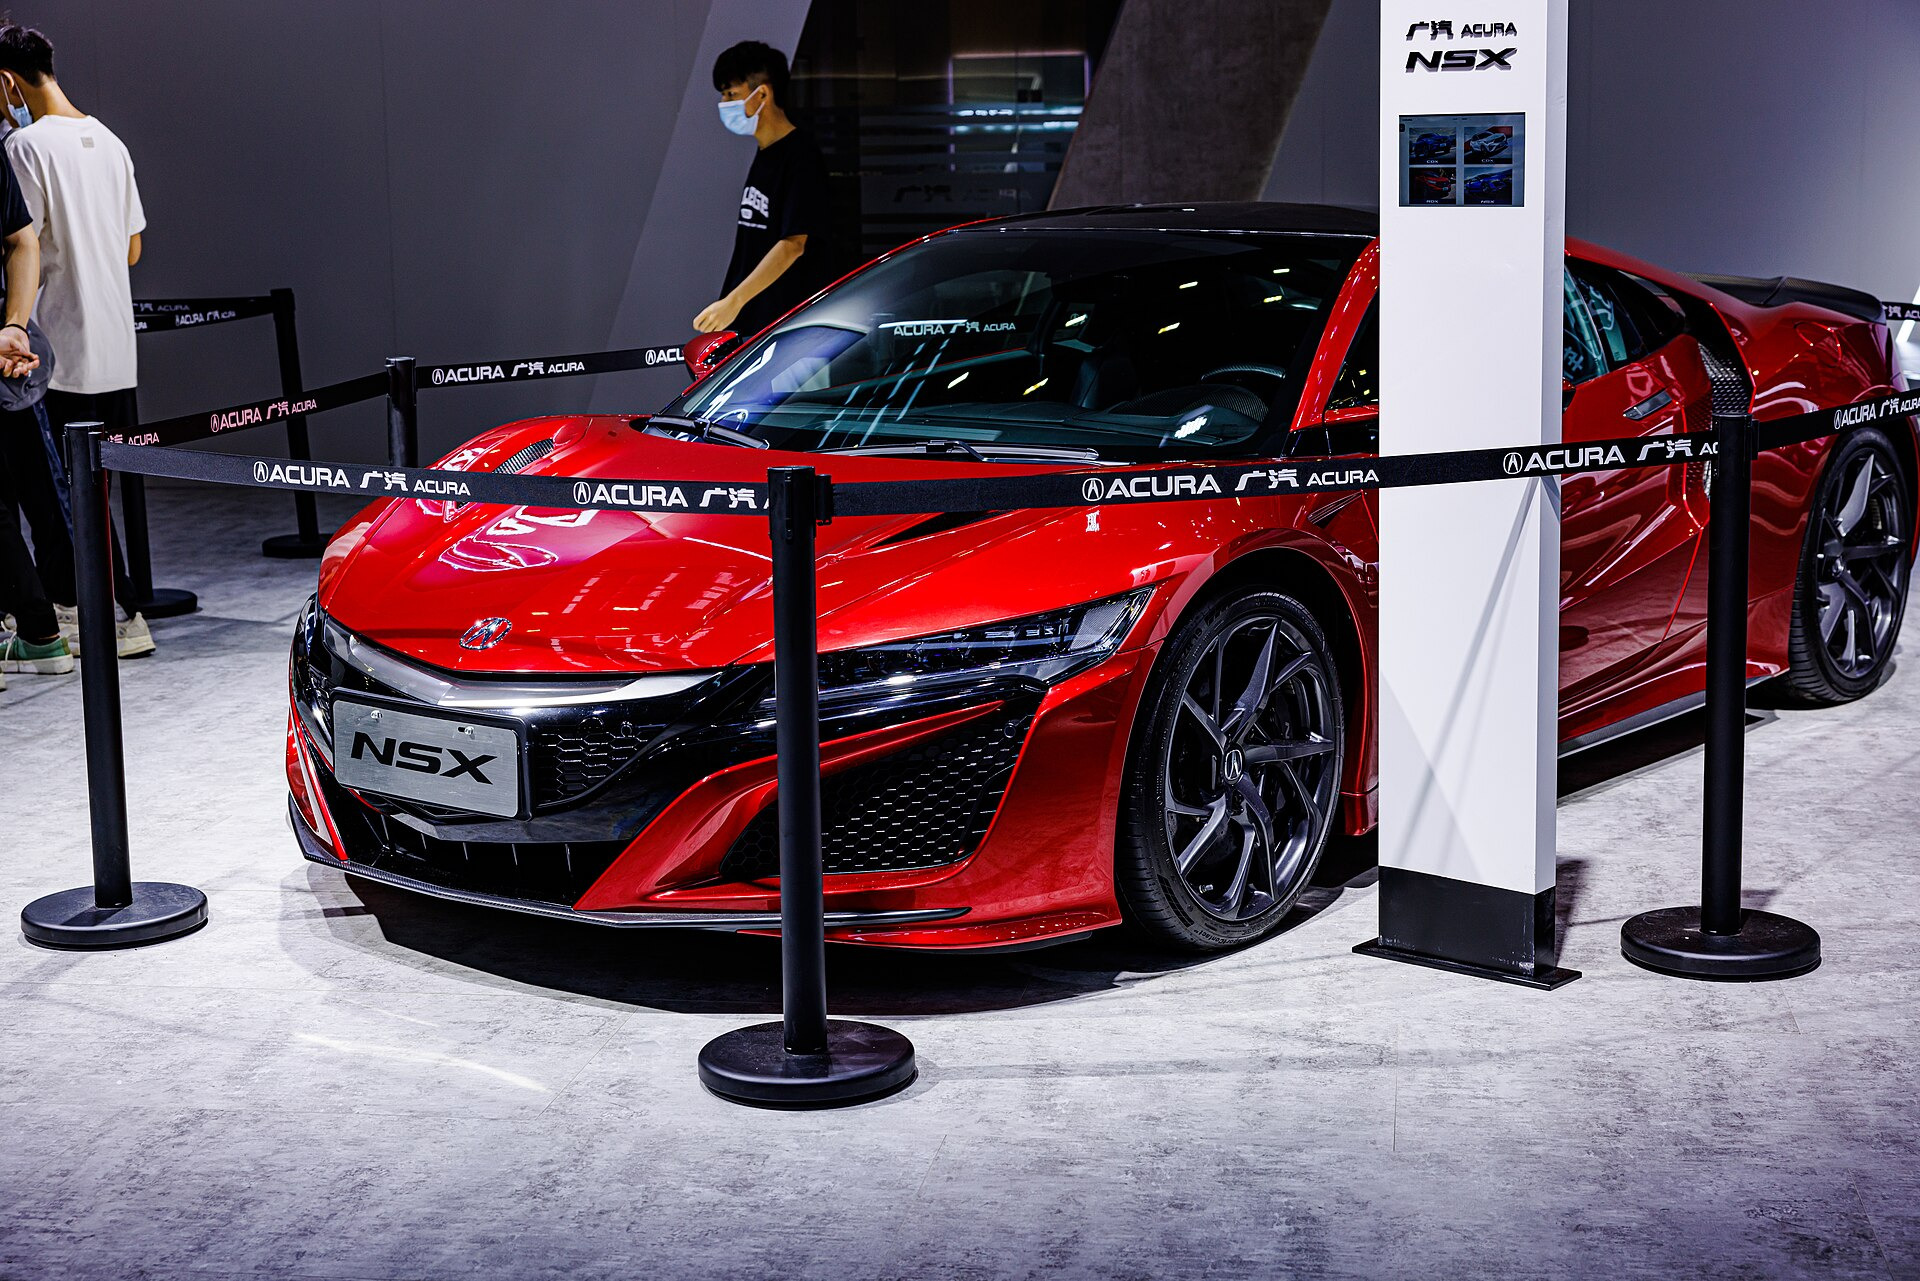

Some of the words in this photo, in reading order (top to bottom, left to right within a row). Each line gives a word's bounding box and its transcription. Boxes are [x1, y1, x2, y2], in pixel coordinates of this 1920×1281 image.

[1405, 20, 1454, 41] 广汽
[1460, 22, 1518, 38] ACURA
[1405, 47, 1518, 73] NSX
[894, 323, 945, 337] ACURA
[984, 322, 1017, 332] ACURA
[444, 364, 505, 383] ACURA
[511, 361, 546, 378] 广汽
[548, 361, 585, 375] ACURA
[219, 407, 262, 430] ACURA
[266, 401, 290, 420] 广汽
[291, 398, 317, 414] ACURA
[1840, 403, 1877, 427] ACURA
[128, 432, 160, 446] ACURA
[1524, 445, 1626, 472] ACURA
[1637, 438, 1694, 461] 广汽
[269, 465, 351, 488] ACURA
[360, 471, 408, 492] 广汽
[413, 479, 471, 496] ACURA
[1105, 474, 1222, 499] ACURA
[1234, 469, 1299, 489] 广汽
[1306, 469, 1380, 487] ACURA
[592, 483, 689, 508] ACURA
[699, 487, 758, 509] 广汽
[351, 731, 498, 785] NSX
